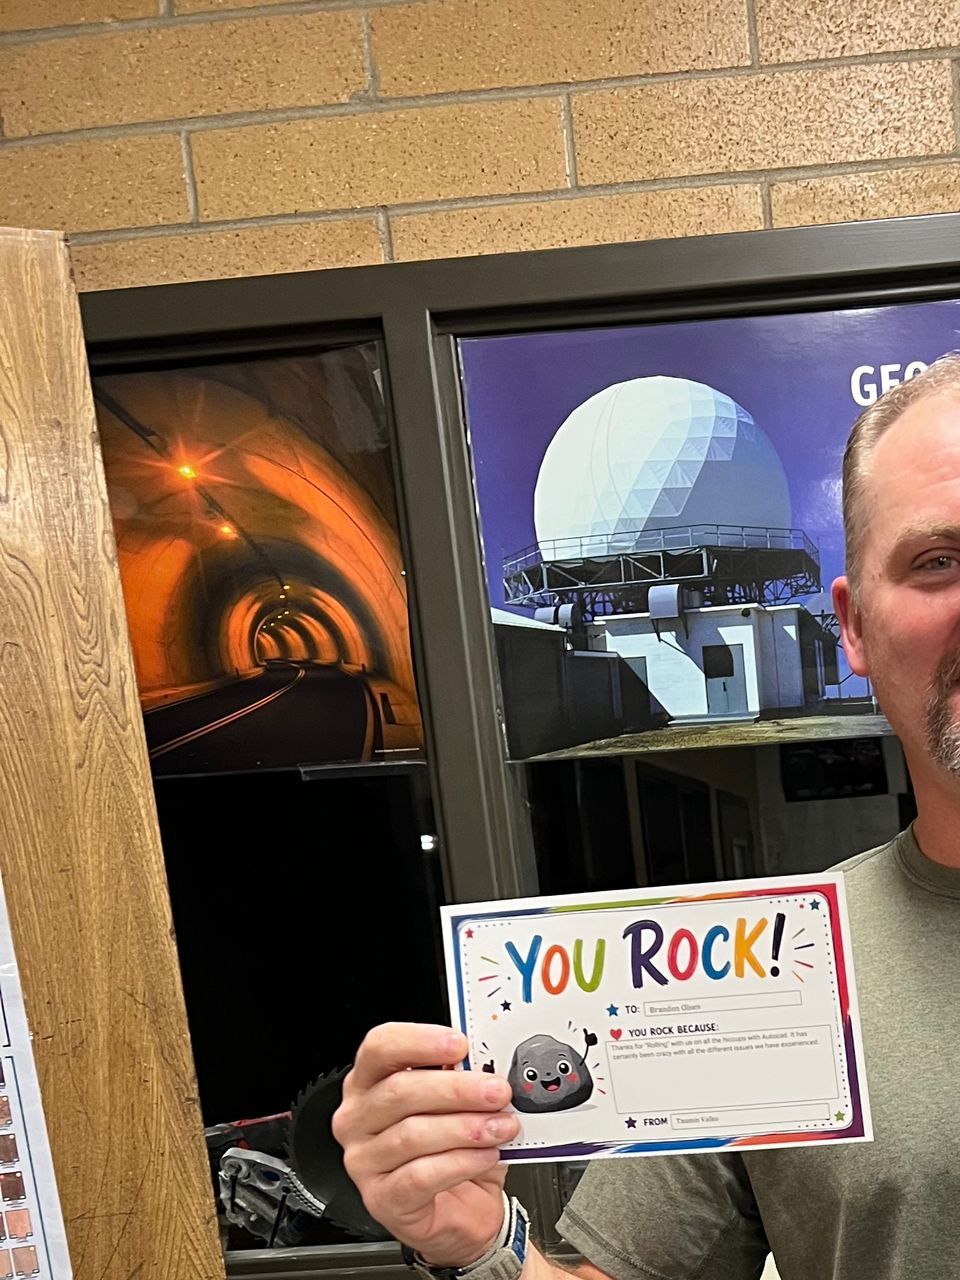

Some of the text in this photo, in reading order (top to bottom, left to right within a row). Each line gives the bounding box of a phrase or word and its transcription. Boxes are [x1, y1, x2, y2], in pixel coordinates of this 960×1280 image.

[505, 912, 786, 1003] YOU ROCK!
[625, 1005, 640, 1014] TO:
[629, 1023, 719, 1037] YOU ROCK BECAUSE:
[643, 1117, 667, 1126] FROM
